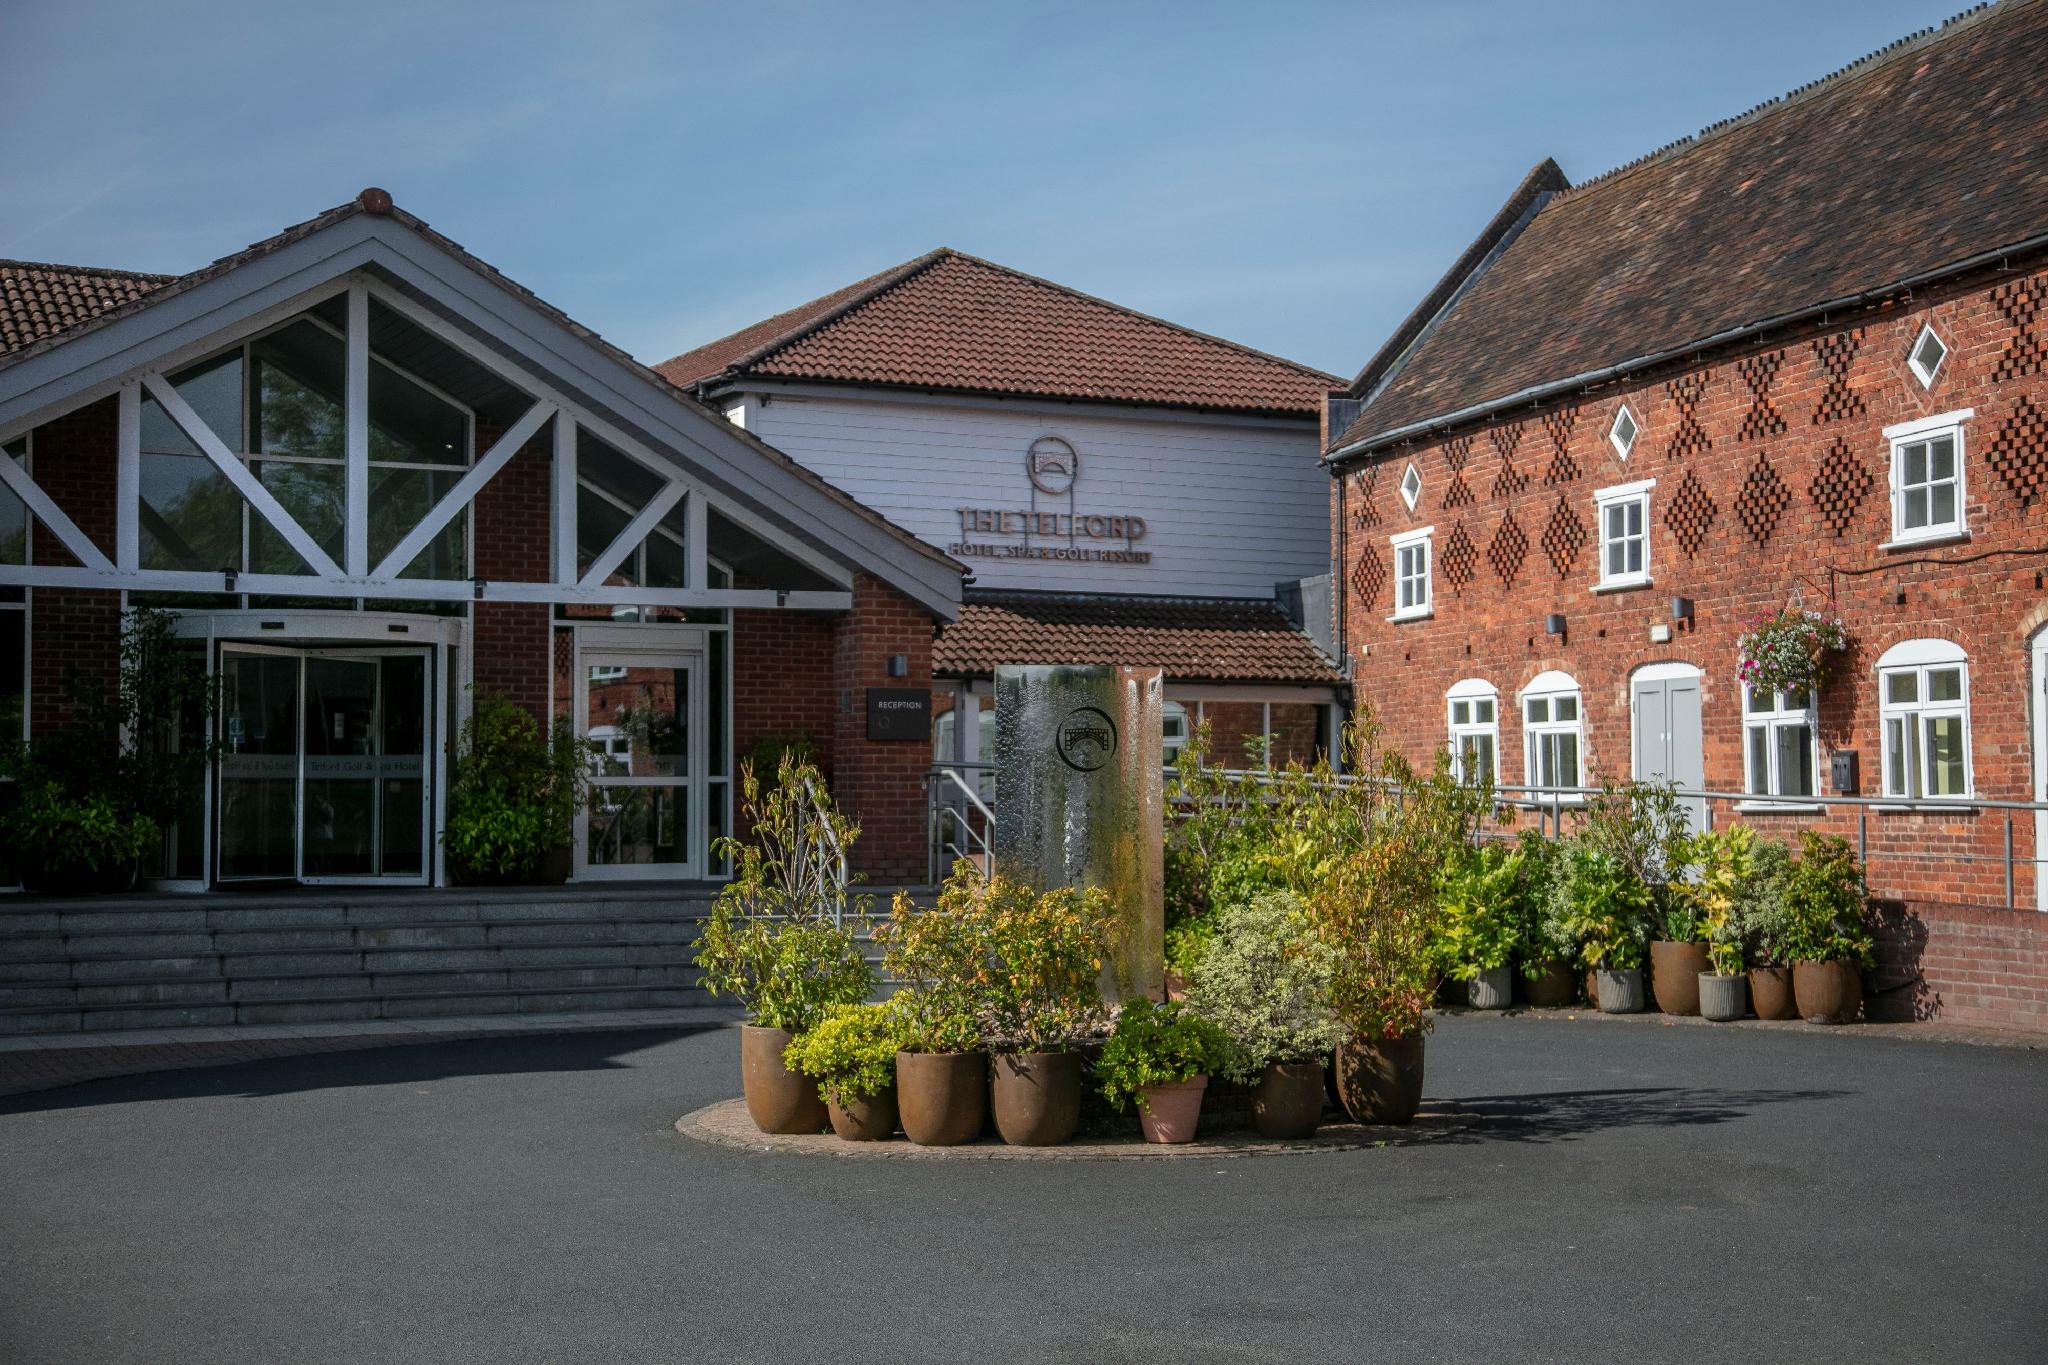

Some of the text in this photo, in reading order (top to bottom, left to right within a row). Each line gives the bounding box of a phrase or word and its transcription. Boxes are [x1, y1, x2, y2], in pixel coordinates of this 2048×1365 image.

[957, 505, 1147, 540] THE TELFORD
[1007, 545, 1036, 559] SPA
[1040, 547, 1050, 560] &
[1055, 547, 1094, 561] GOLF
[878, 701, 922, 709] RECEPTION
